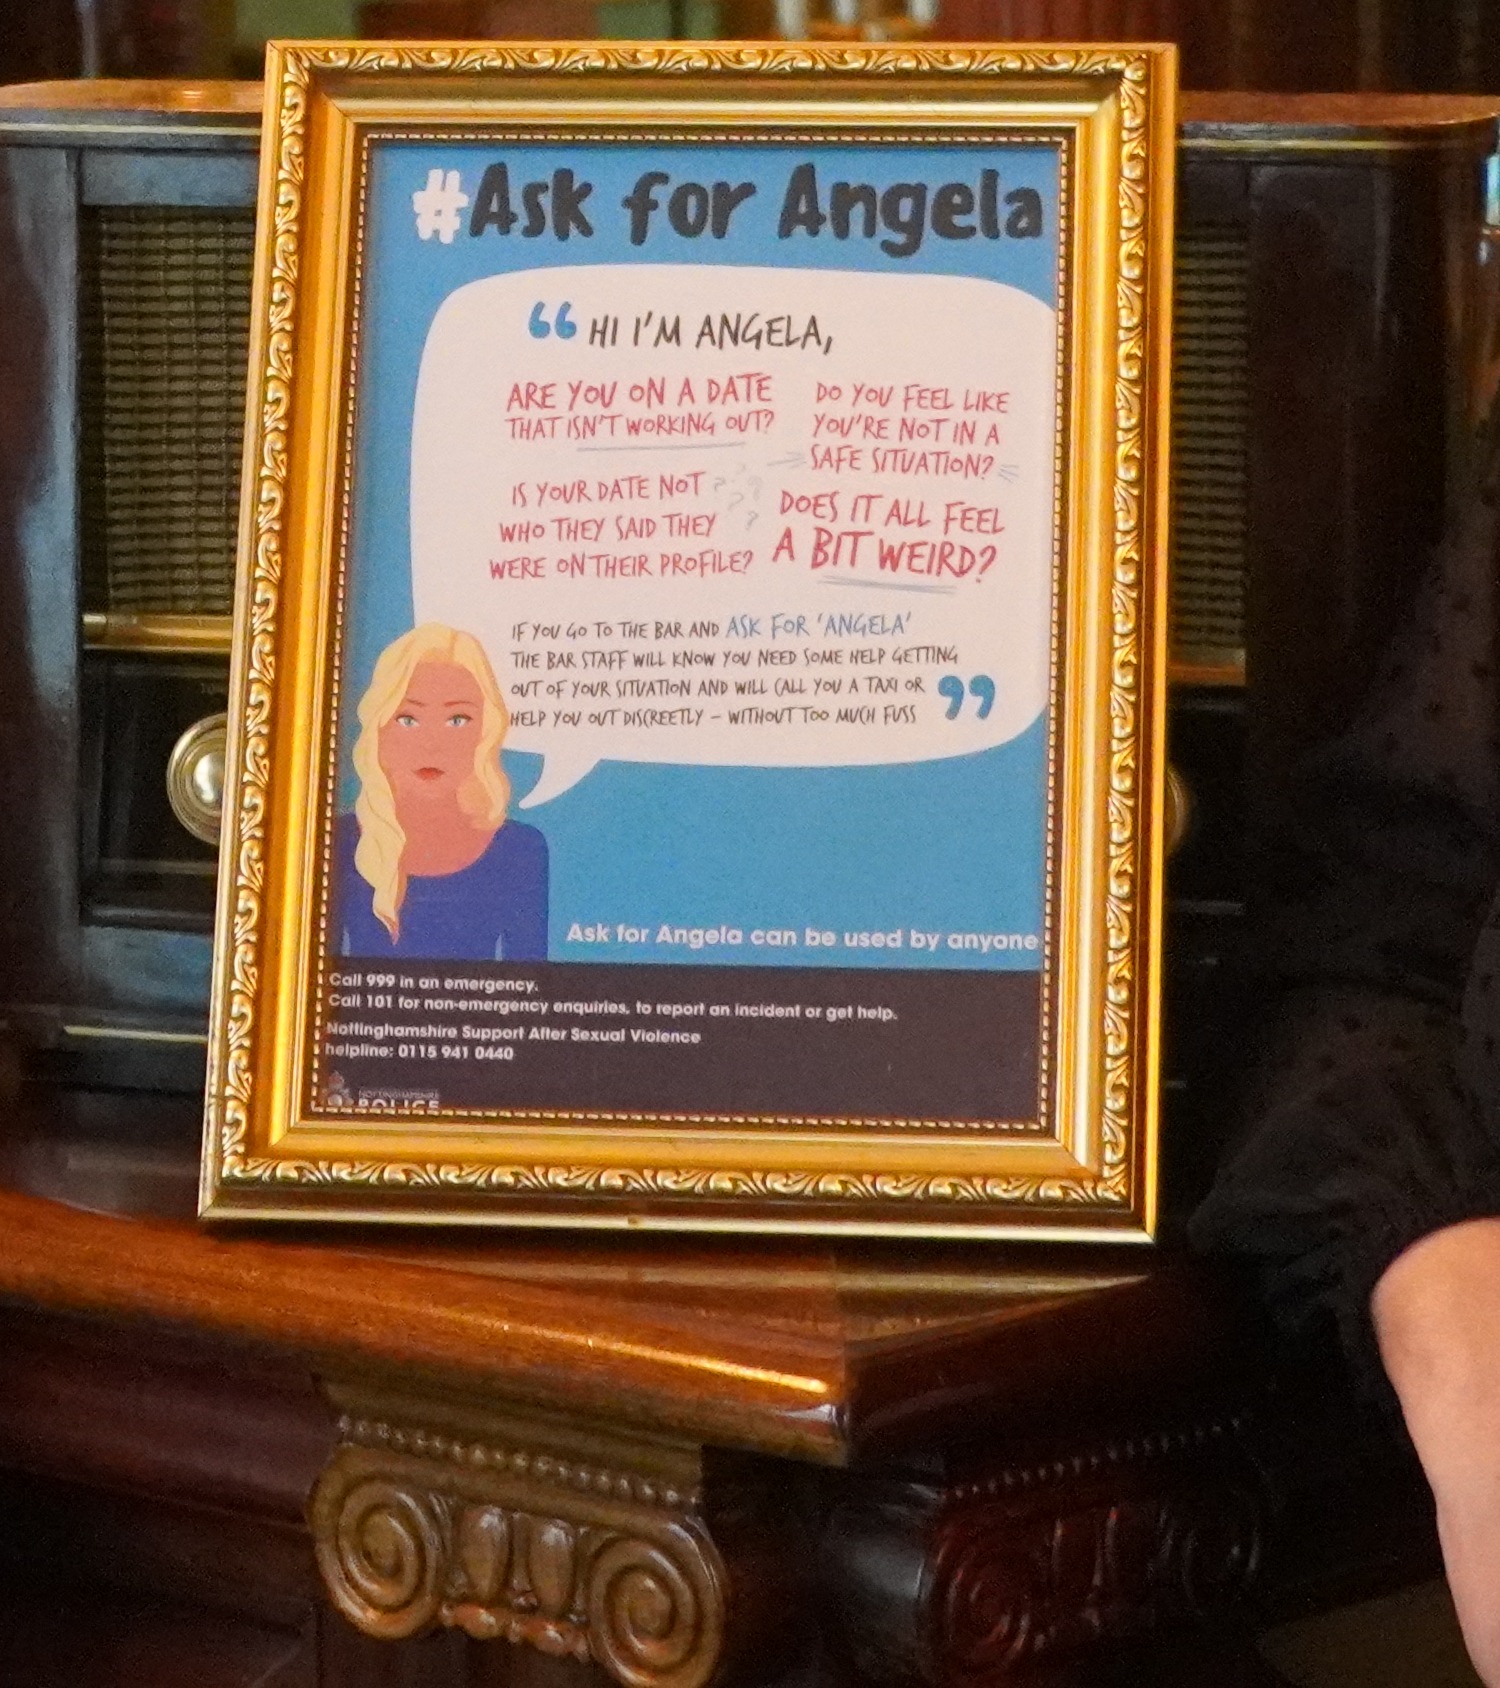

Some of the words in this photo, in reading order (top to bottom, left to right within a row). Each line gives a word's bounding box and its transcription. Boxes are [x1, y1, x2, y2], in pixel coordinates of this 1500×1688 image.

[412, 161, 595, 244] #Ask
[622, 171, 757, 246] for
[778, 162, 1044, 257] Angela
[588, 315, 619, 348] HI
[696, 312, 835, 355] ANGELA,
[506, 382, 557, 412] ARE
[568, 380, 617, 411] YOU
[629, 377, 665, 408] ON
[677, 377, 695, 406] A
[706, 372, 772, 405] DATE
[816, 382, 842, 404] DO
[851, 383, 894, 407] YOU
[903, 384, 954, 412] FEEL
[963, 389, 1010, 413] LIKE
[505, 416, 563, 440] THAT
[567, 414, 623, 439] ISN'T
[626, 412, 715, 436] WORKING
[726, 409, 775, 434] OUT?
[813, 413, 890, 440] YOU'RE
[899, 418, 949, 442] NOT
[953, 420, 976, 446] IN
[985, 423, 1000, 446] A
[811, 444, 863, 473] SAFE
[872, 447, 994, 479] SITUATION?
[512, 482, 527, 507] IS
[536, 480, 592, 507] YOUR
[598, 476, 650, 502] DATE
[659, 471, 706, 500] NOT
[499, 521, 545, 543] WHO
[550, 517, 606, 542] THEY
[615, 515, 657, 541] SAID
[662, 513, 716, 538] THEY
[780, 490, 840, 523] DOES
[850, 494, 883, 523] IT
[884, 499, 930, 527] ALL
[943, 501, 1005, 536] FEEL
[489, 557, 547, 580] WERE
[557, 552, 586, 578] ON
[588, 554, 653, 578] THEIR
[660, 549, 754, 577] PROFILE?
[772, 526, 796, 562] A
[811, 526, 875, 570] BIT
[879, 538, 997, 583] WEIRD?
[512, 622, 528, 642] IF
[532, 622, 561, 641] YOU
[566, 622, 587, 641] GO
[595, 621, 613, 639] TO
[618, 621, 648, 639] THE
[655, 621, 684, 640] BAR
[689, 621, 720, 639] AND
[725, 614, 761, 639] ASK
[771, 612, 810, 640] FOR
[510, 651, 540, 669] THE
[547, 651, 576, 670] BAR
[581, 650, 629, 670] STAFF
[632, 651, 665, 668] WILL
[671, 650, 716, 669] KNOW
[722, 650, 751, 668] YOU
[758, 650, 796, 667] NEED
[804, 648, 843, 667] SOME
[849, 648, 886, 665] HELP
[891, 645, 958, 664] GETTING
[510, 680, 544, 698] OUT
[546, 679, 567, 698] OF
[572, 680, 612, 699] YOUR
[615, 678, 691, 698] SITUATION
[698, 678, 728, 697] AND
[734, 678, 768, 696] WILL
[774, 677, 807, 697] CALL
[813, 677, 842, 696] YOU
[848, 677, 859, 694] A
[865, 675, 898, 693] TAXI
[905, 676, 926, 694] OR
[510, 710, 546, 727] HELP
[552, 710, 582, 727] YOU
[588, 708, 622, 727] OUT
[623, 708, 704, 727] DISCREETLY
[728, 706, 798, 725] WITHOUT
[800, 706, 829, 723] TOO
[836, 705, 875, 725] MUCH
[883, 704, 916, 726] FUSS
[566, 923, 610, 943] Ask
[616, 924, 648, 944] for
[655, 924, 743, 949] Angela
[750, 929, 797, 947] can
[805, 927, 835, 947] be
[843, 929, 902, 949] used
[909, 929, 939, 953] by
[947, 933, 1040, 953] anyone
[329, 972, 362, 987] Call
[366, 973, 396, 987] 999
[400, 975, 413, 988] in
[419, 977, 439, 989] an
[444, 978, 539, 994] emergency.
[329, 994, 361, 1007] Call
[366, 994, 392, 1009] 101
[399, 996, 420, 1010] for
[424, 998, 548, 1015] non-emergency
[636, 1000, 652, 1014] to
[656, 1001, 704, 1018] report
[709, 1004, 730, 1017] an
[735, 1003, 800, 1018] incident
[805, 1005, 822, 1018] or
[826, 1005, 853, 1022] get
[857, 1005, 898, 1022] help.
[326, 1022, 457, 1040] Nottinghamshire
[462, 1026, 524, 1042] Support
[528, 1027, 566, 1041] After
[571, 1028, 625, 1042] Sexual
[630, 1029, 701, 1043] Violence
[325, 1042, 393, 1059] helpline:
[399, 1045, 437, 1059] 0115
[441, 1046, 469, 1060] 941
[474, 1046, 514, 1060] 0440
